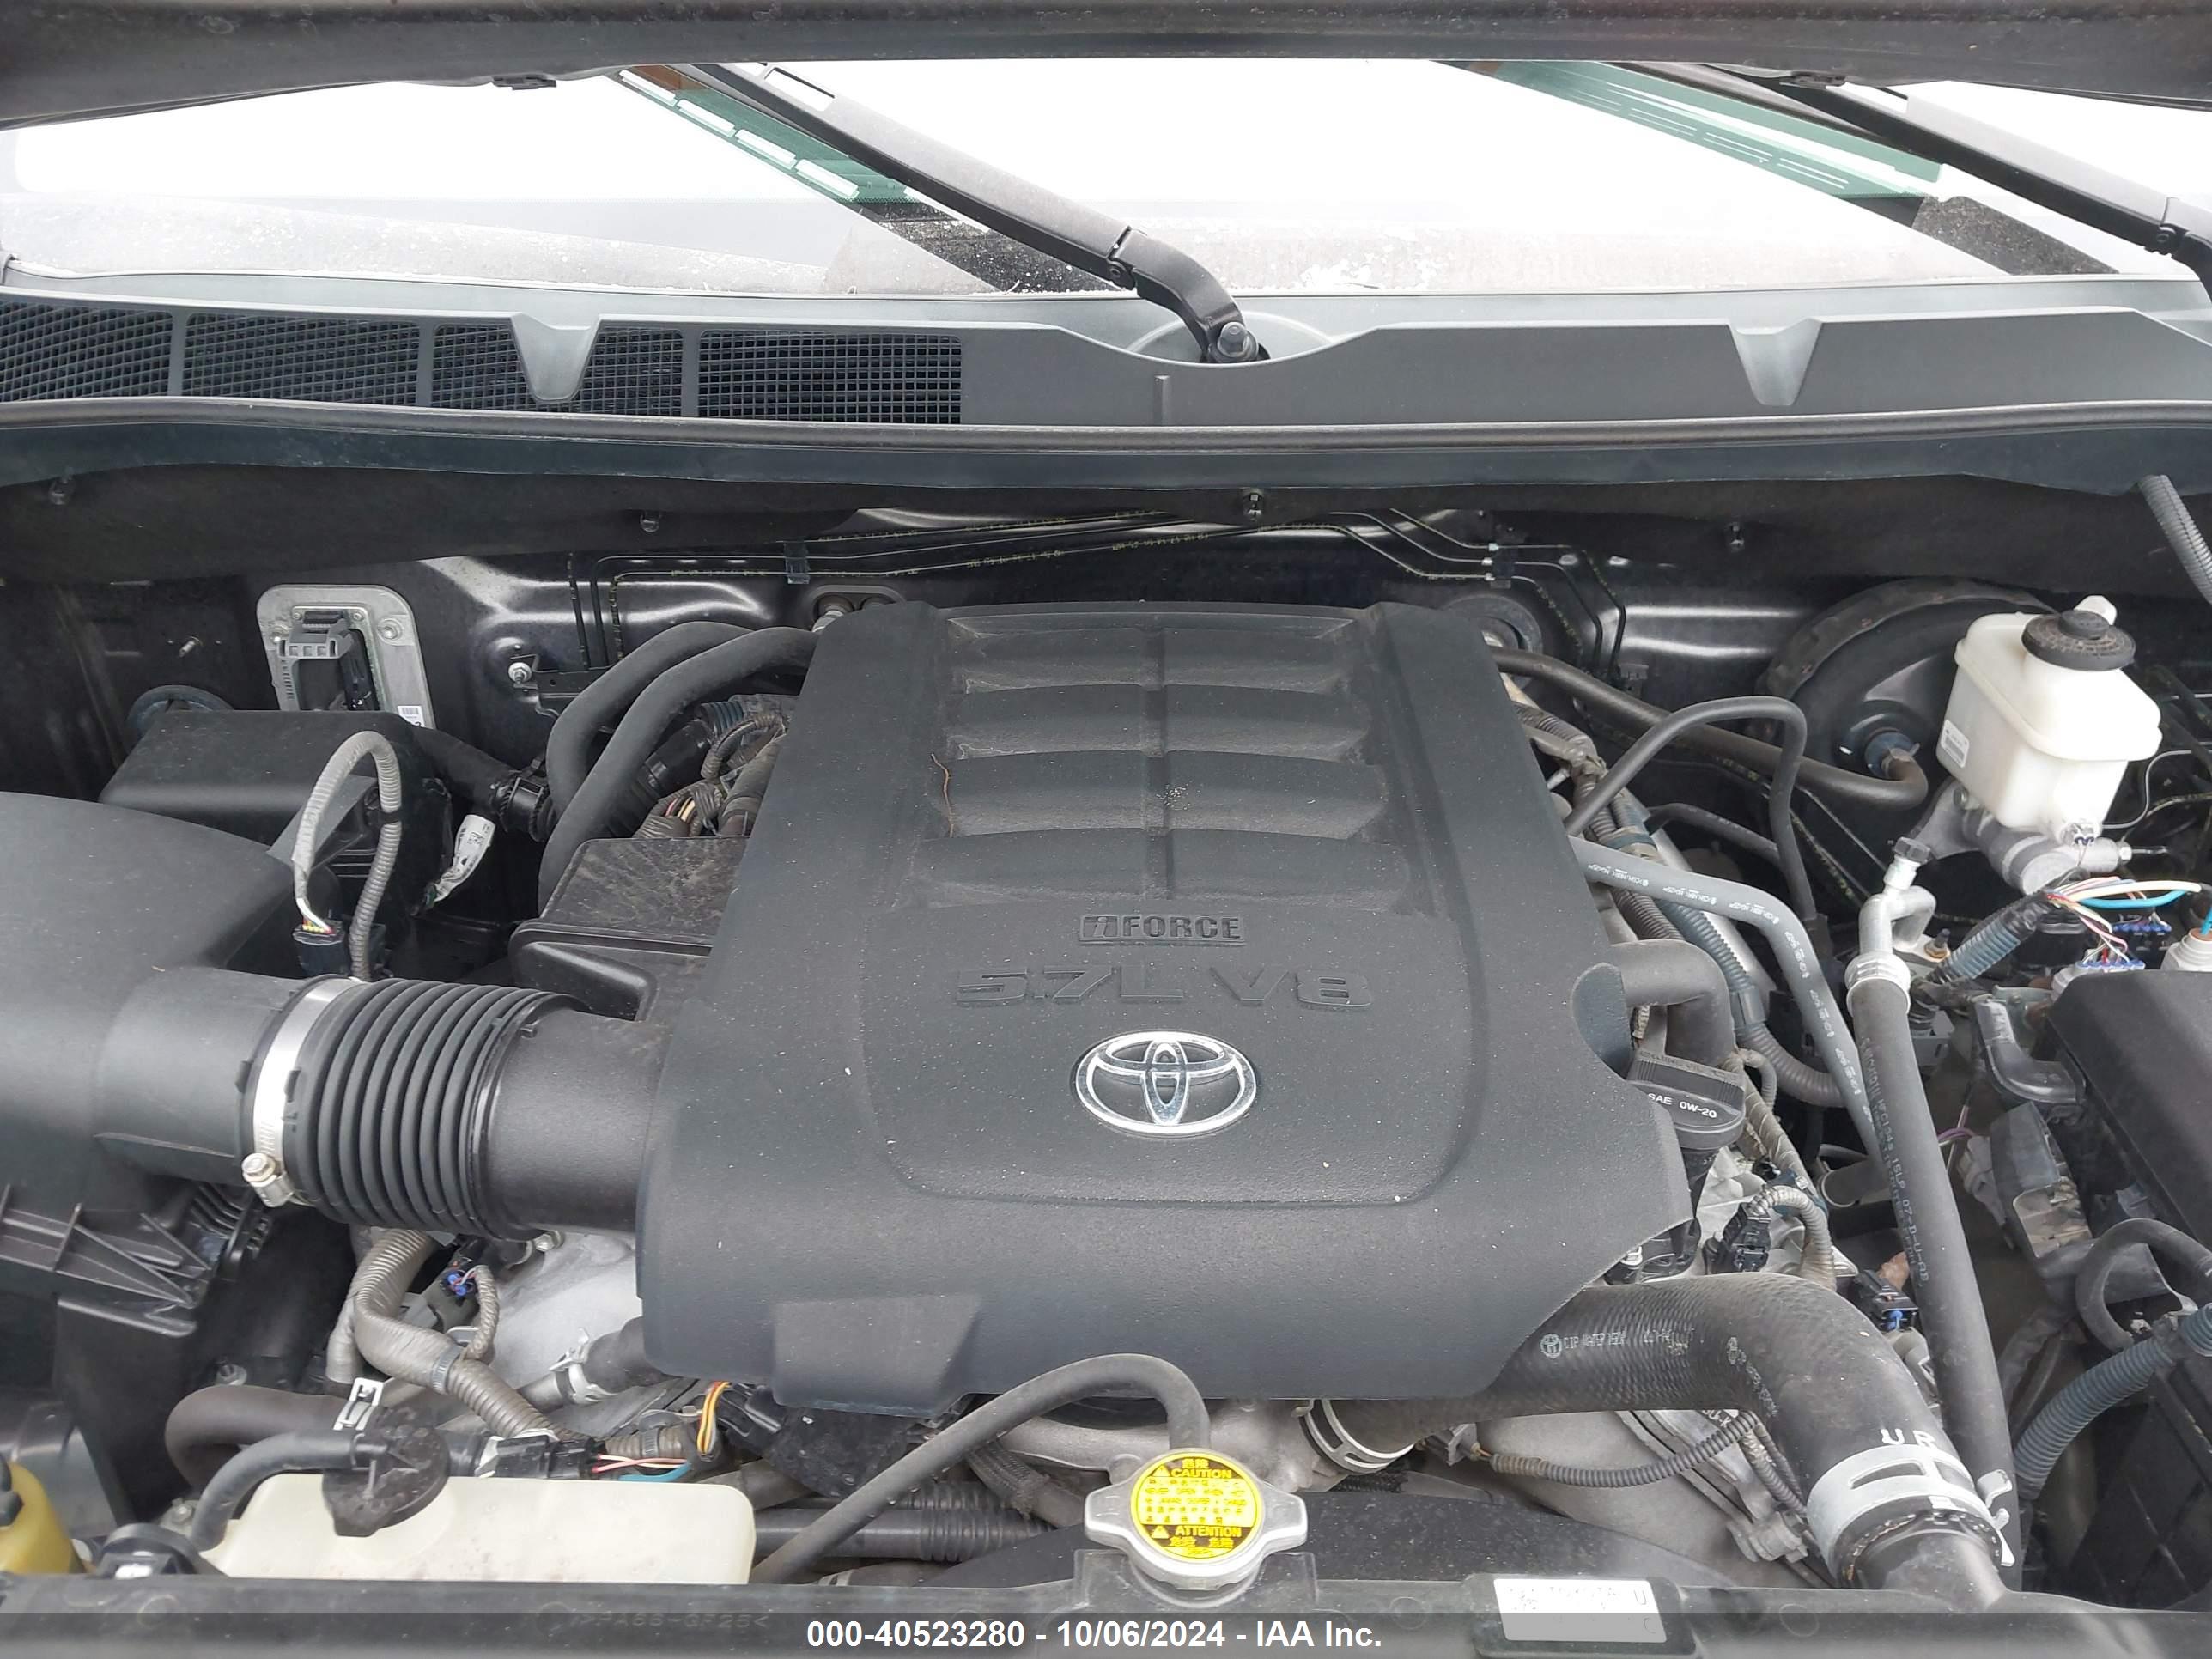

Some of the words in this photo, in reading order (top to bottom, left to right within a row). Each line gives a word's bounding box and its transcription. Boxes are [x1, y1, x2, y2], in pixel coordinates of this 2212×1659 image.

[955, 965, 1184, 1005] 5.7L
[1209, 966, 1374, 1008] V8
[1648, 1093, 1673, 1105] SAE
[1170, 1468, 1232, 1479] CAUTION
[1175, 1525, 1242, 1537] ATTENTION
